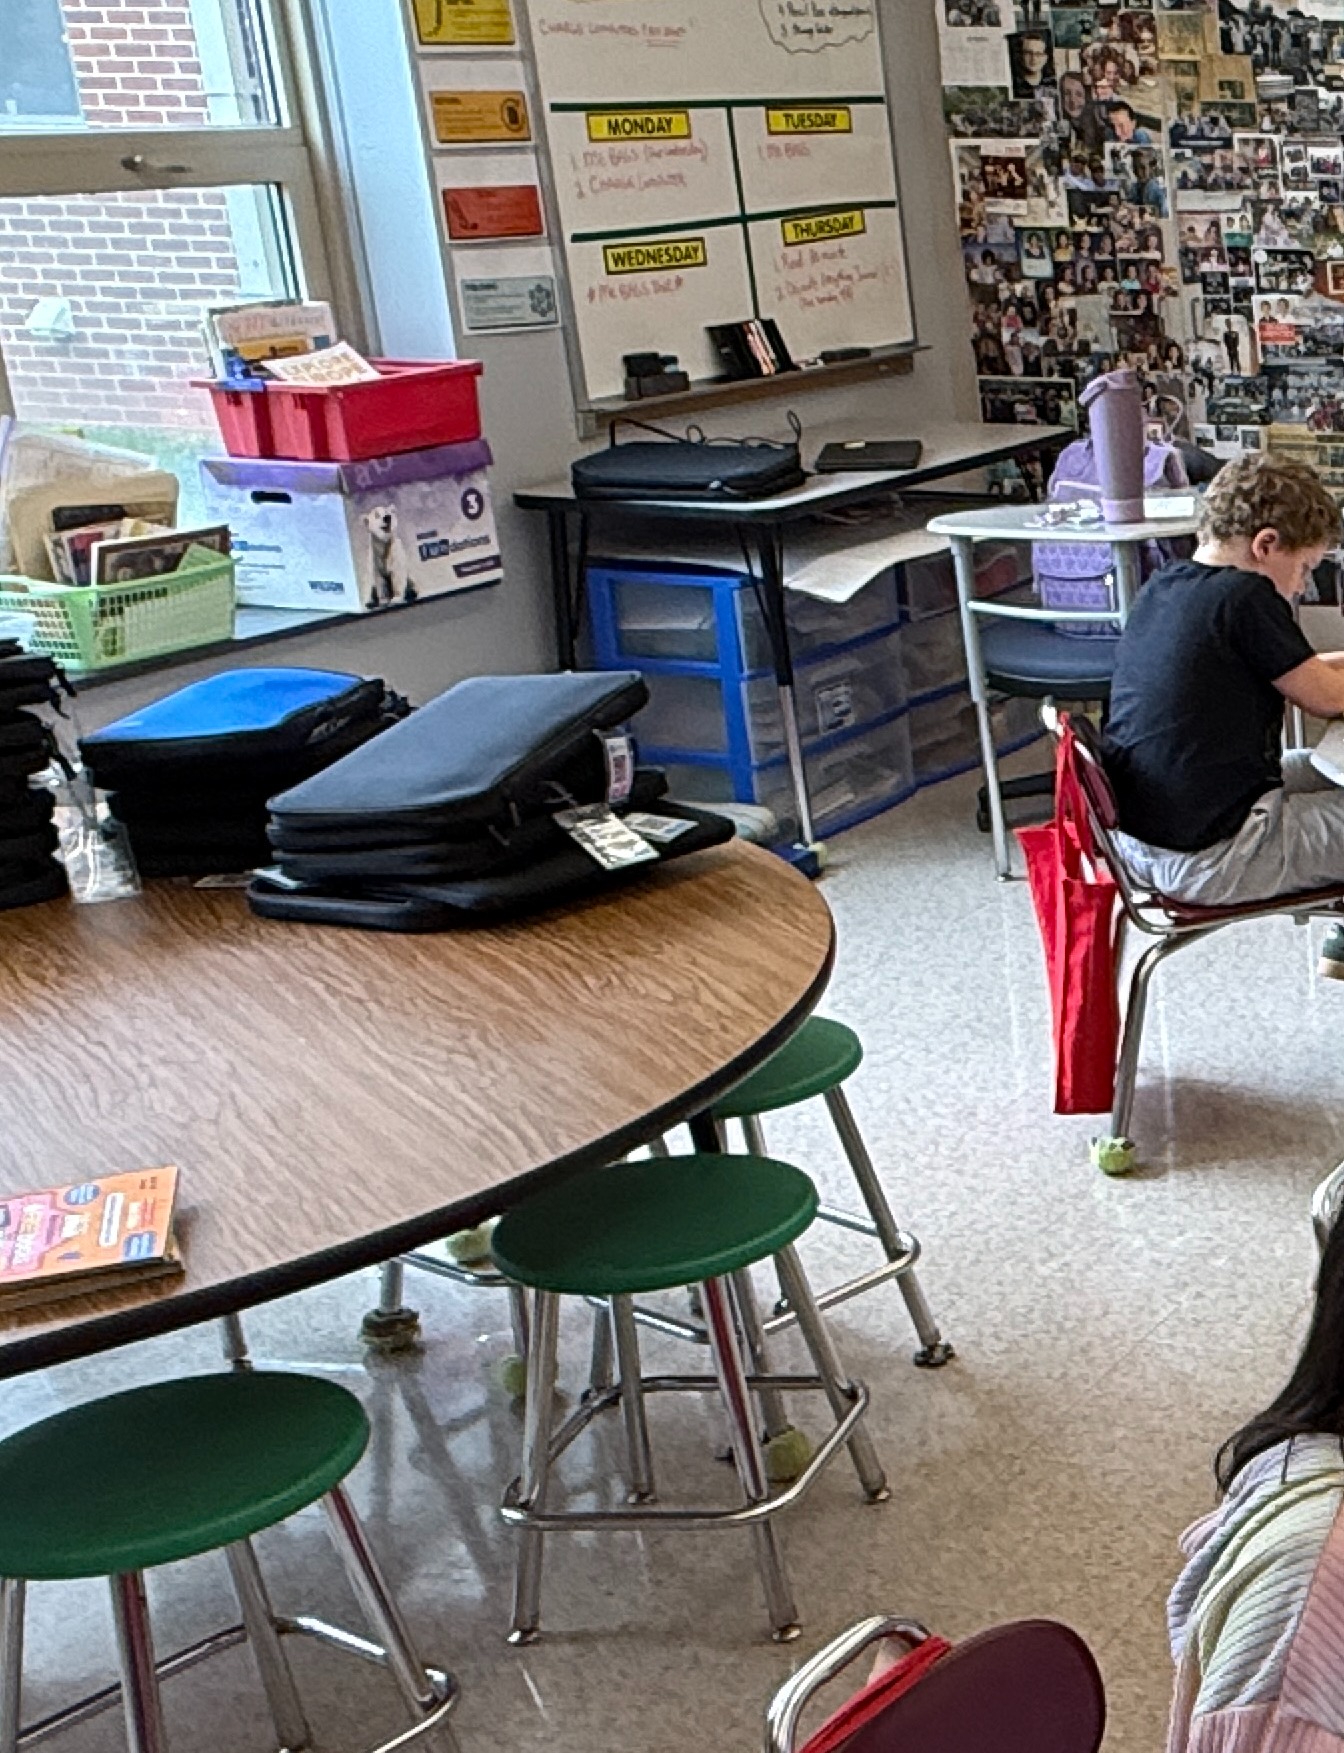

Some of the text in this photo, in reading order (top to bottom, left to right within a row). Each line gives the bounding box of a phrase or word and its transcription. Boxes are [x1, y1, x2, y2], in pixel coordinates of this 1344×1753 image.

[607, 116, 673, 135] MONDAY
[782, 112, 838, 128] TUESDAY
[792, 215, 855, 239] THURSDAY
[610, 246, 700, 268] WEDNESDAY
